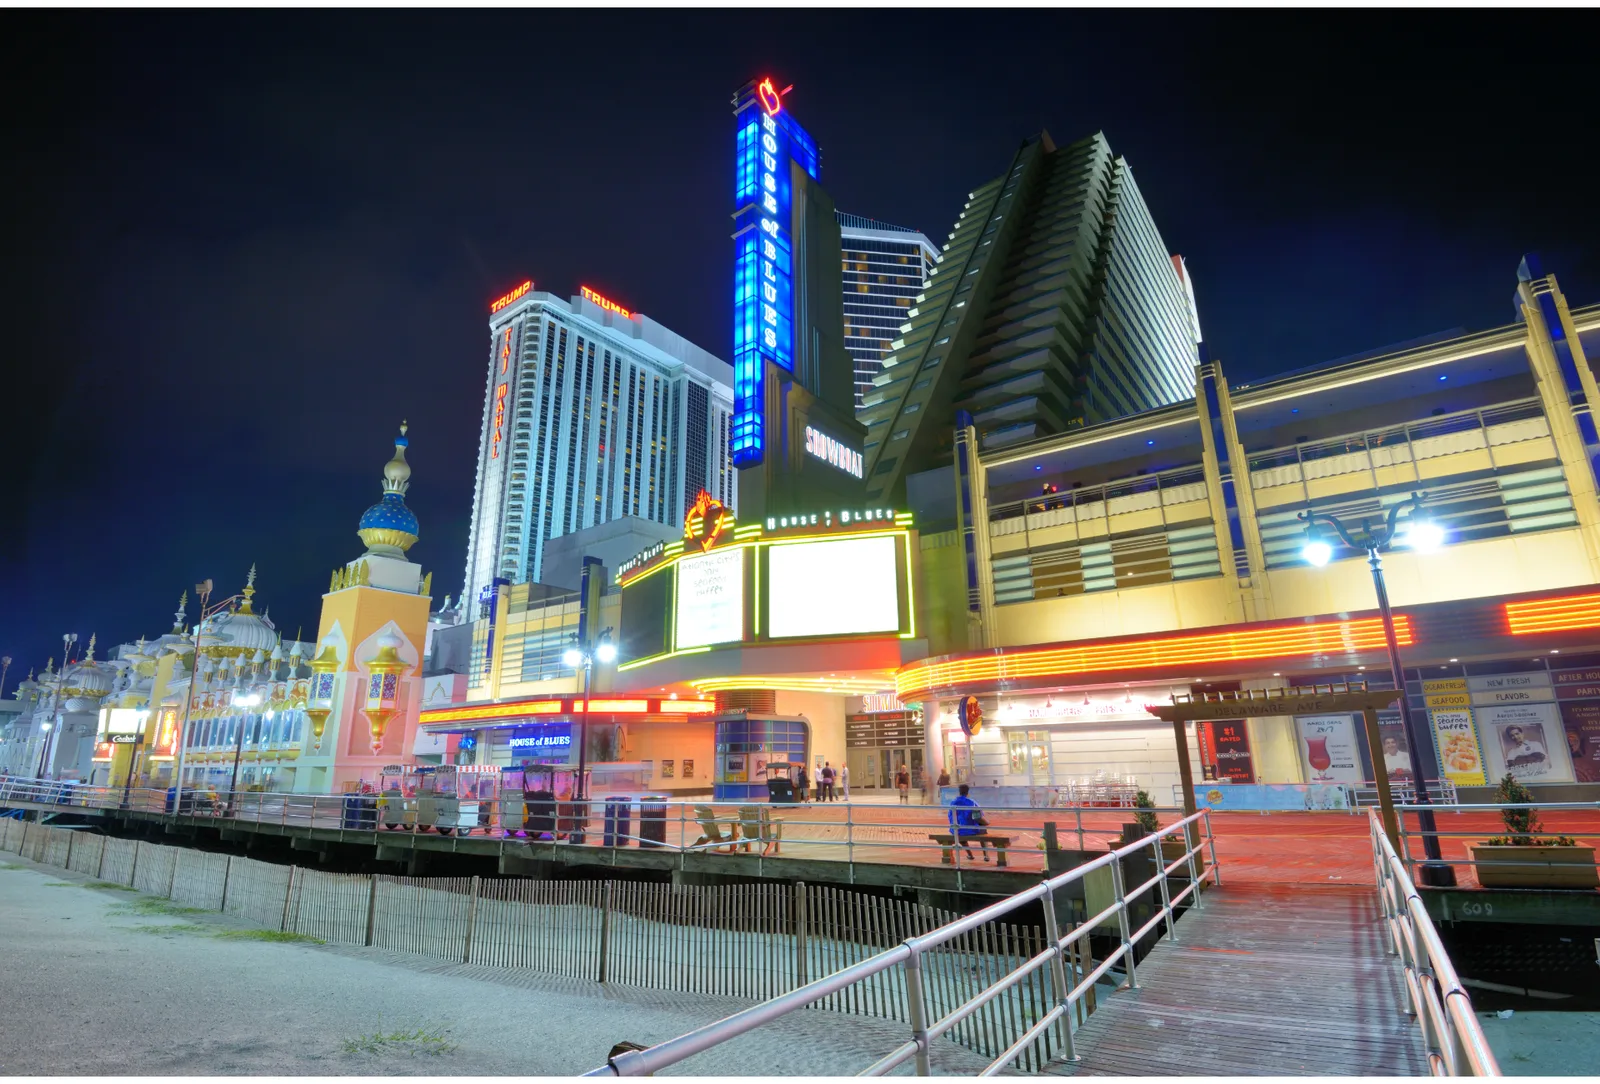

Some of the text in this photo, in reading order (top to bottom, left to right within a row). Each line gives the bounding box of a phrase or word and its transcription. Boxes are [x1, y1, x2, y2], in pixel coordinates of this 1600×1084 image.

[761, 112, 779, 347] HOUSE of BLUES
[489, 280, 531, 313] TRUMP
[581, 285, 629, 319] TRUMP
[492, 327, 512, 459] TAJ MAHAL
[805, 425, 863, 479] SHOWBOAT
[767, 514, 817, 530] HOUSE
[841, 509, 893, 523] BLUES
[1487, 677, 1531, 687] NEW FRESH
[1559, 673, 1583, 682] AFTER
[1424, 682, 1466, 691] OCEAN FRESH
[1432, 697, 1464, 705] SEAFOOD
[1496, 692, 1530, 701] FLAVORS
[1215, 701, 1323, 716] DELAWARE AVE
[509, 736, 570, 747] HOUSE of BLUES
